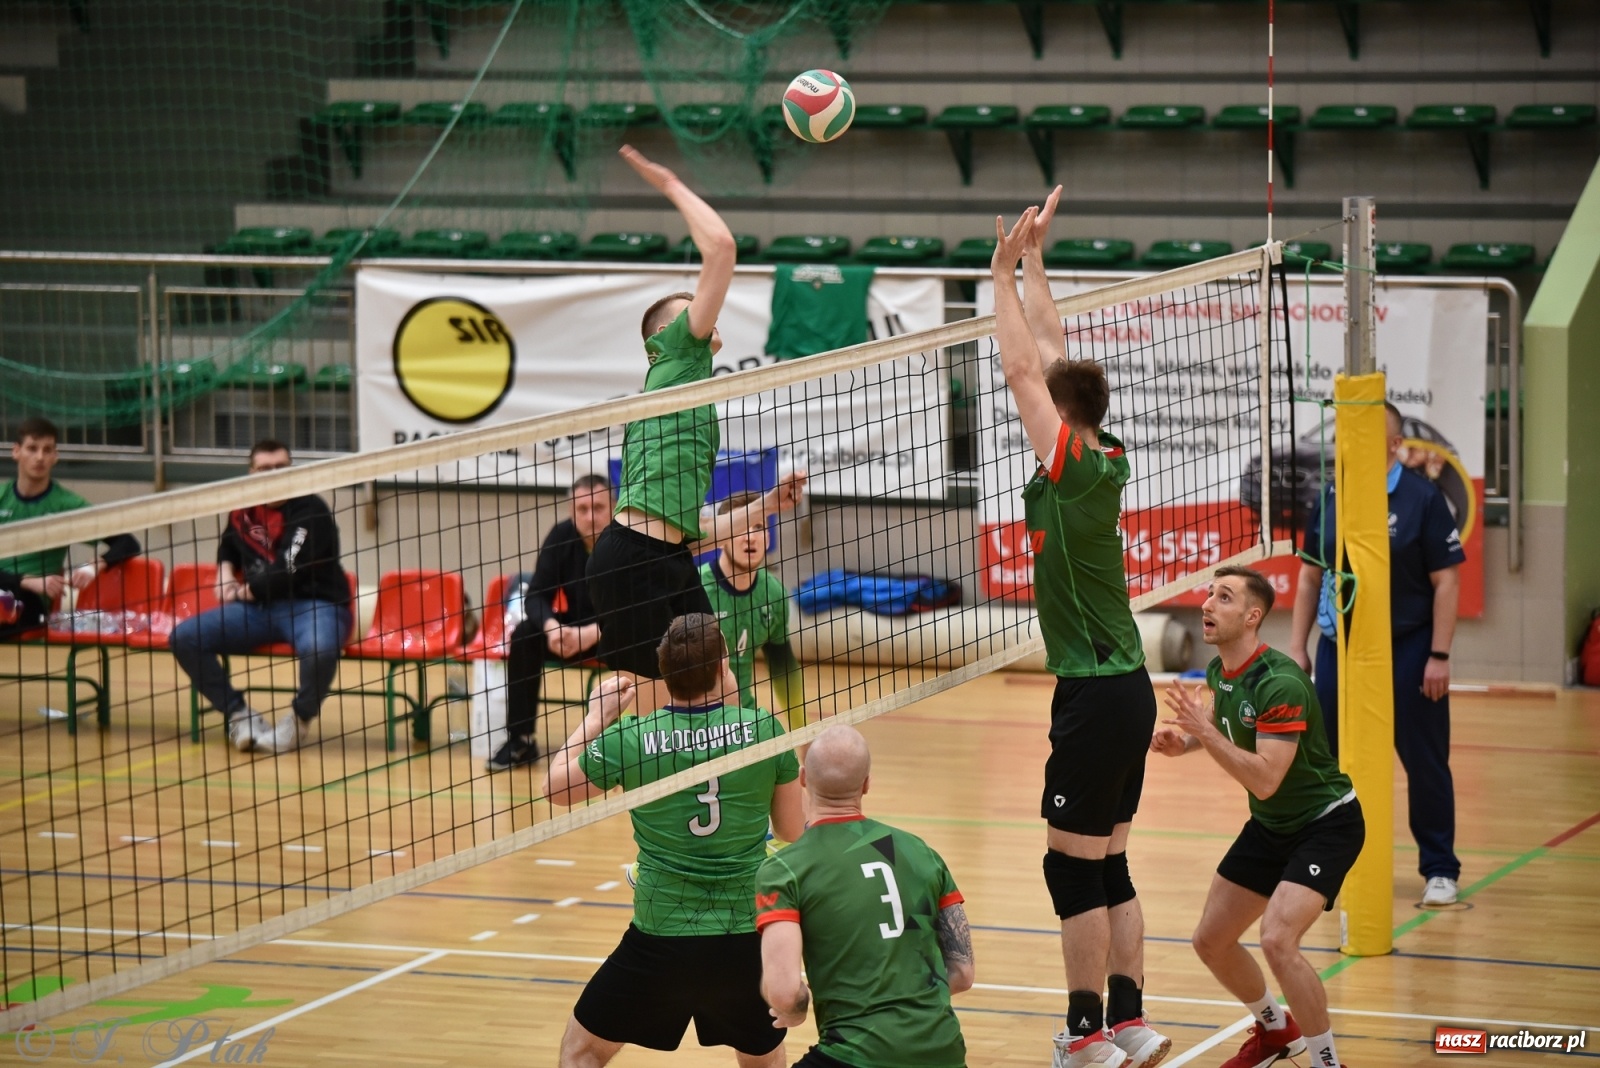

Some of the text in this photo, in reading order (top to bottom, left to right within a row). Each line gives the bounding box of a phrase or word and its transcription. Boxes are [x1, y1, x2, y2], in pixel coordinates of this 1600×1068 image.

[1230, 302, 1389, 323] SAMOCHODW
[1157, 530, 1221, 564] 555
[643, 721, 756, 755] WŁODOWICE
[688, 776, 722, 837] 3
[860, 861, 905, 939] 3
